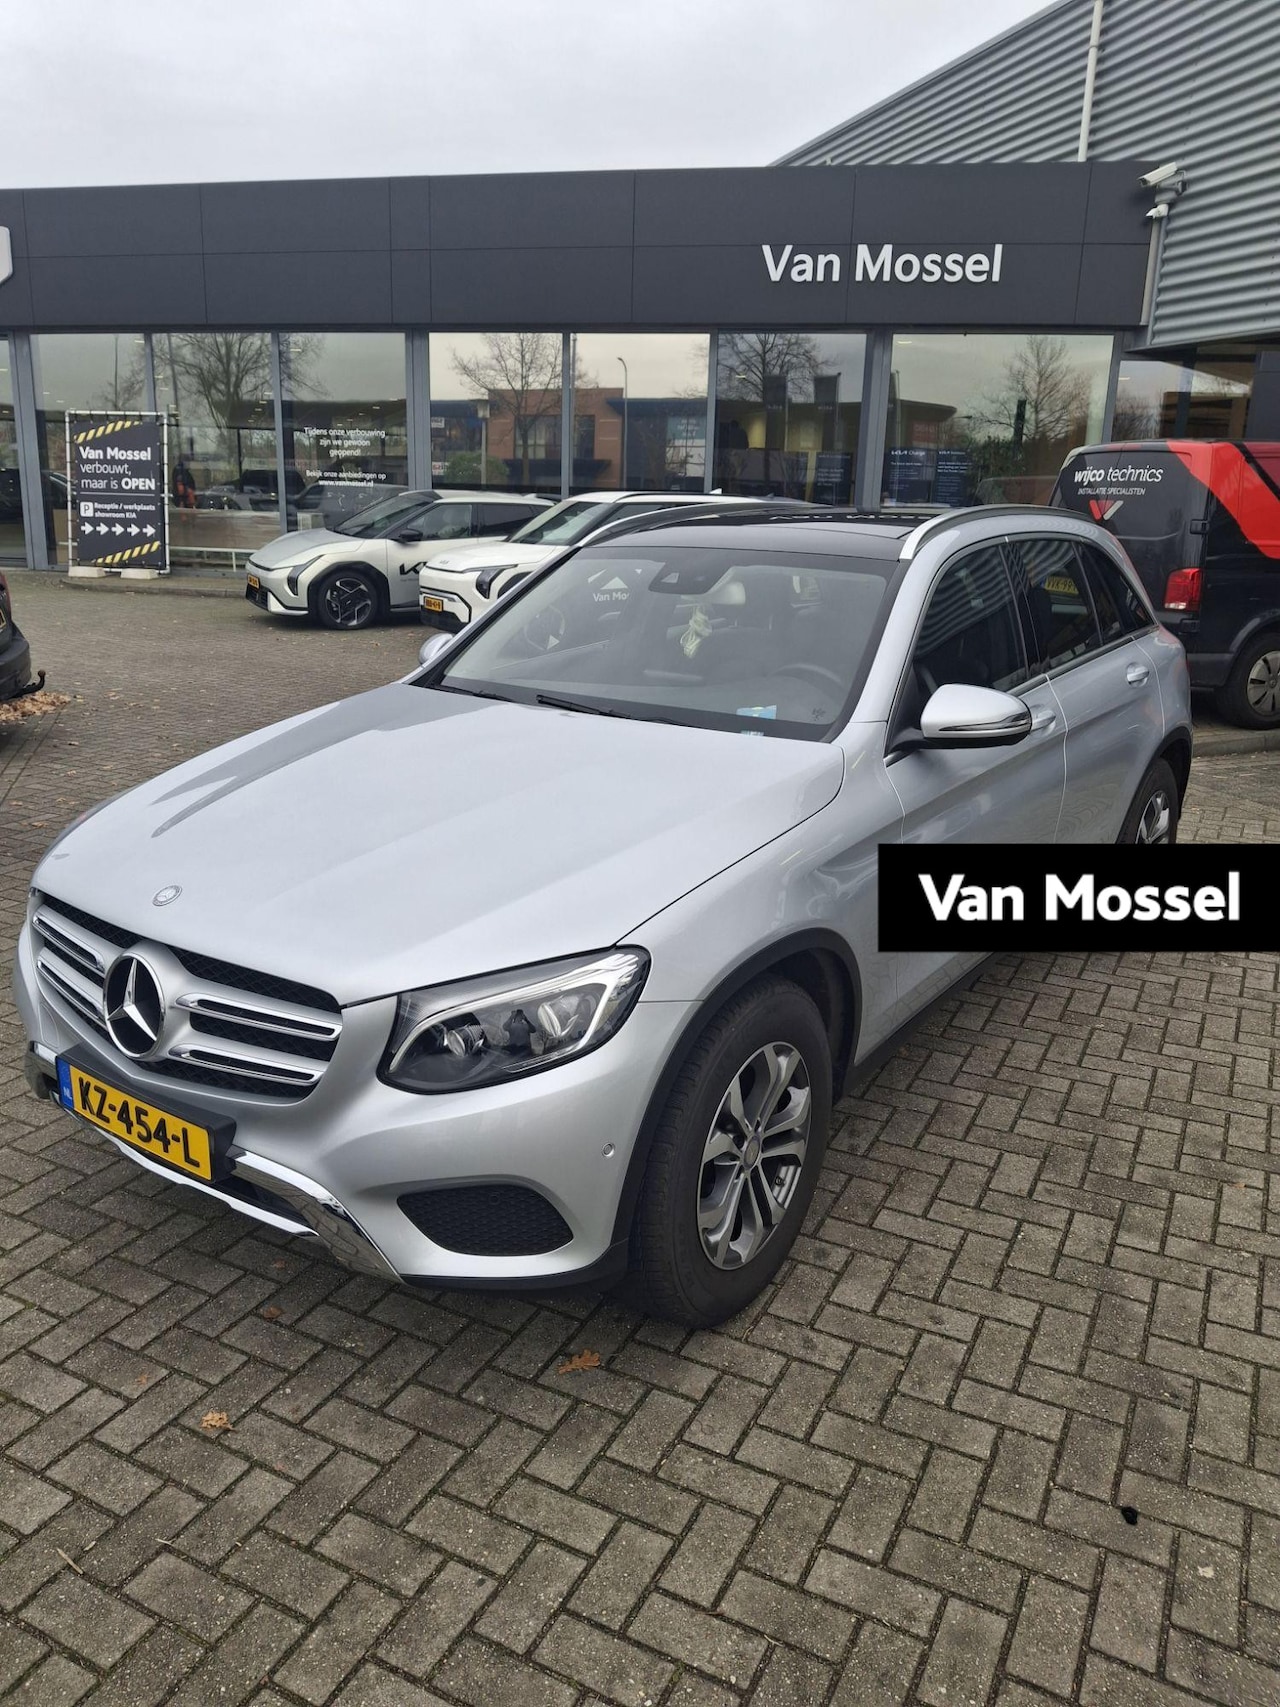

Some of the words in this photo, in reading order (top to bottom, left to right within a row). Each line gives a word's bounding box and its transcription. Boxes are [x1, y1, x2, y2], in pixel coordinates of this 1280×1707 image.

[761, 244, 841, 282] Van
[855, 243, 1003, 283] Mossel
[304, 427, 328, 437] Tijdens
[346, 428, 386, 438] verbouwing
[320, 438, 331, 447] zijn
[79, 446, 104, 459] Van
[106, 447, 151, 460] Mossel
[329, 449, 361, 458] geopend!
[80, 461, 131, 475] verbouwt,
[306, 469, 322, 478] Bekijk
[338, 471, 377, 480] aanbiedingen
[1074, 466, 1104, 486] wijco
[1107, 464, 1164, 482] technics
[81, 479, 108, 489] maar
[110, 477, 118, 489] is
[121, 478, 155, 490] OPEN
[94, 502, 119, 510] Receptie
[123, 503, 156, 511] werkplaats
[593, 593, 610, 602] Van
[78, 1076, 200, 1168] KZ-454-L
